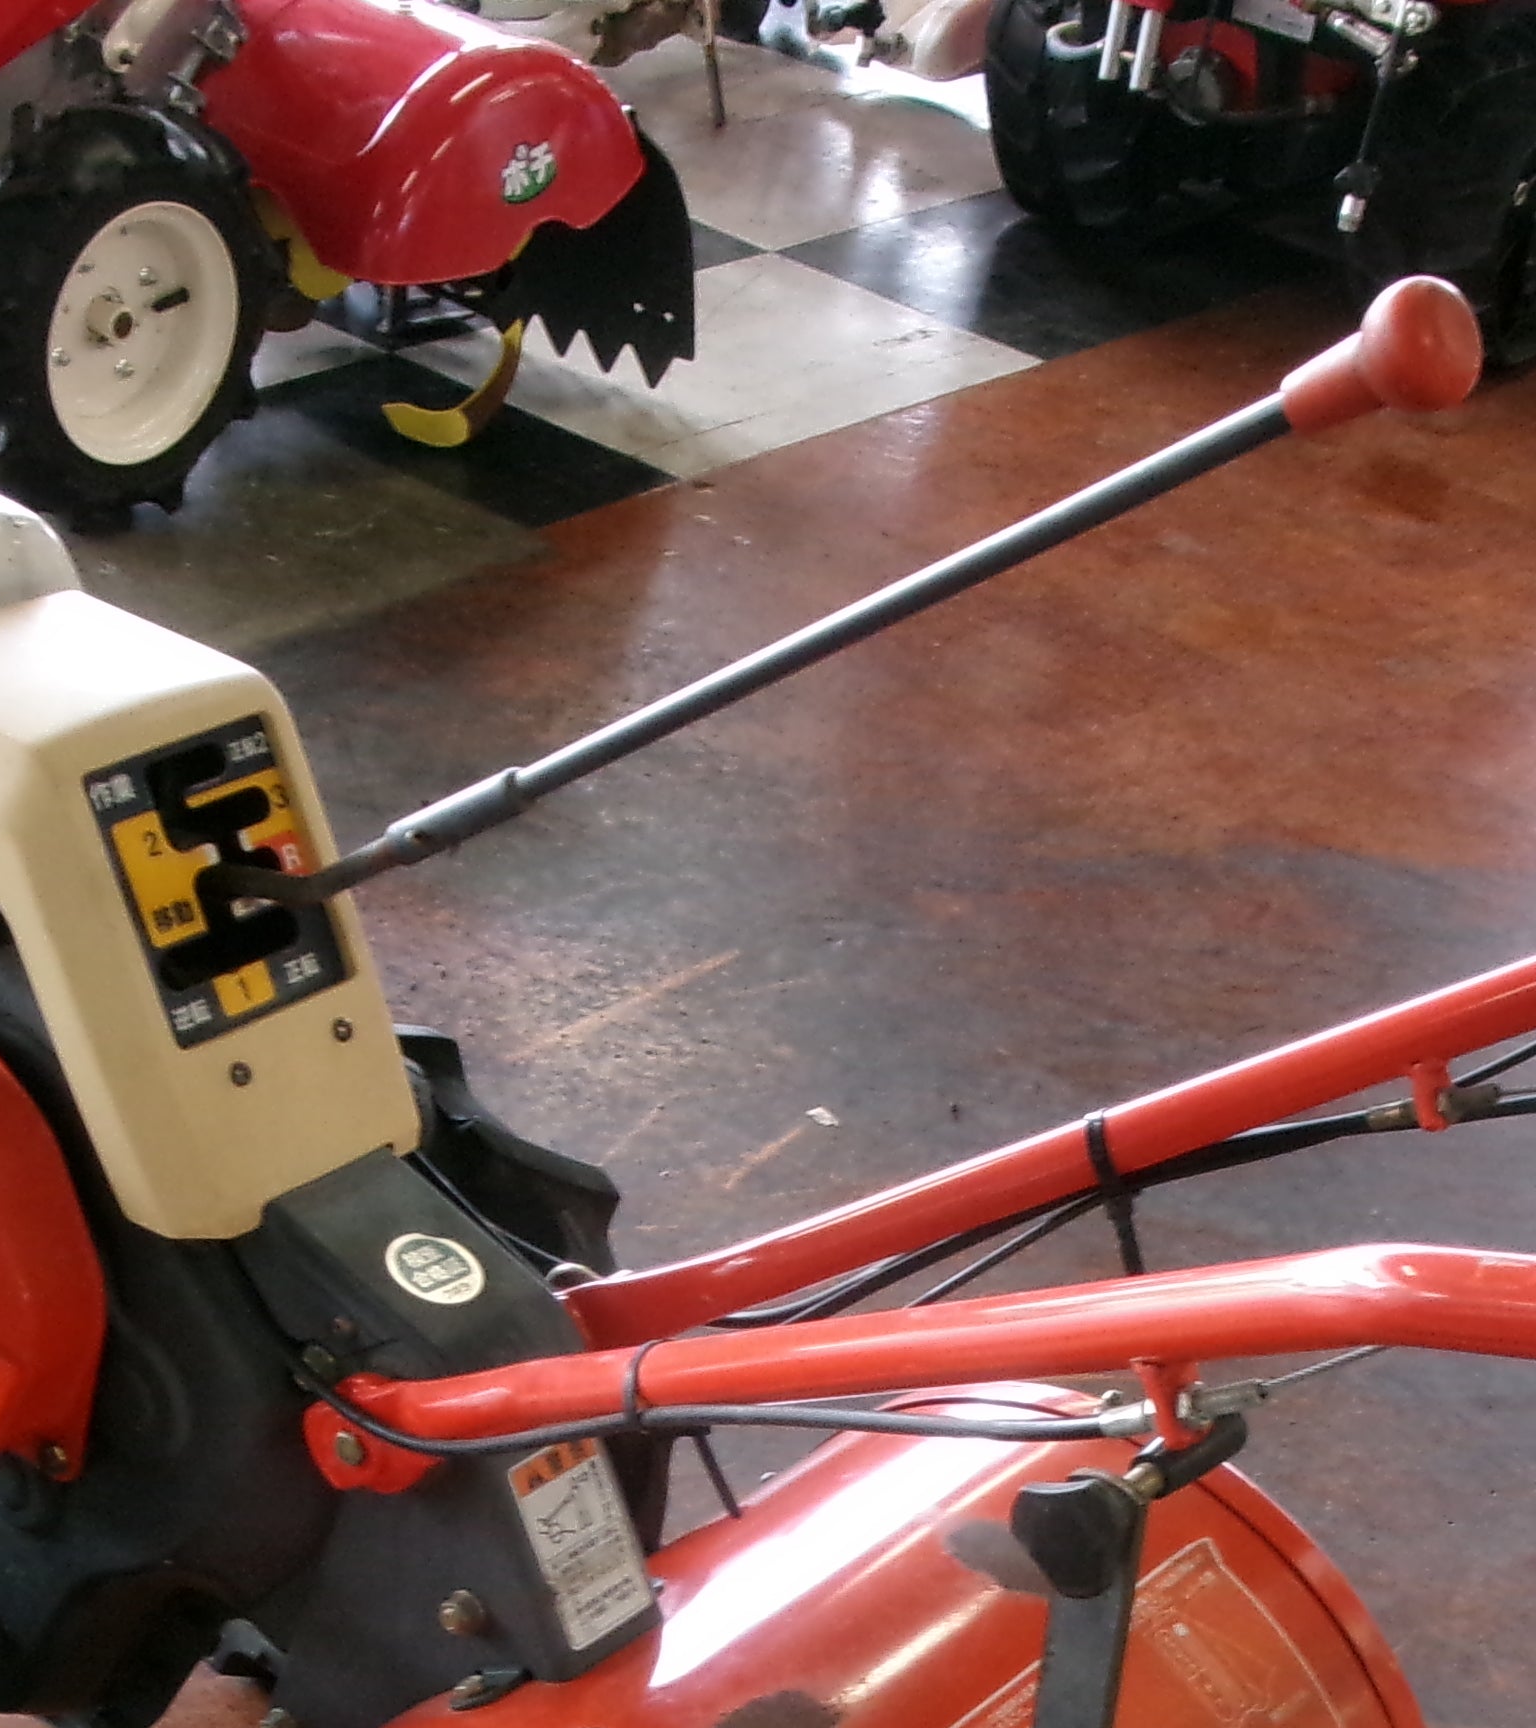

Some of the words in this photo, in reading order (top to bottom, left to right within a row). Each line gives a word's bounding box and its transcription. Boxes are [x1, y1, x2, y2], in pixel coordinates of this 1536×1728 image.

[501, 141, 554, 197] ポチ
[269, 783, 291, 809] 3
[143, 830, 163, 858] 2
[280, 842, 303, 869] R
